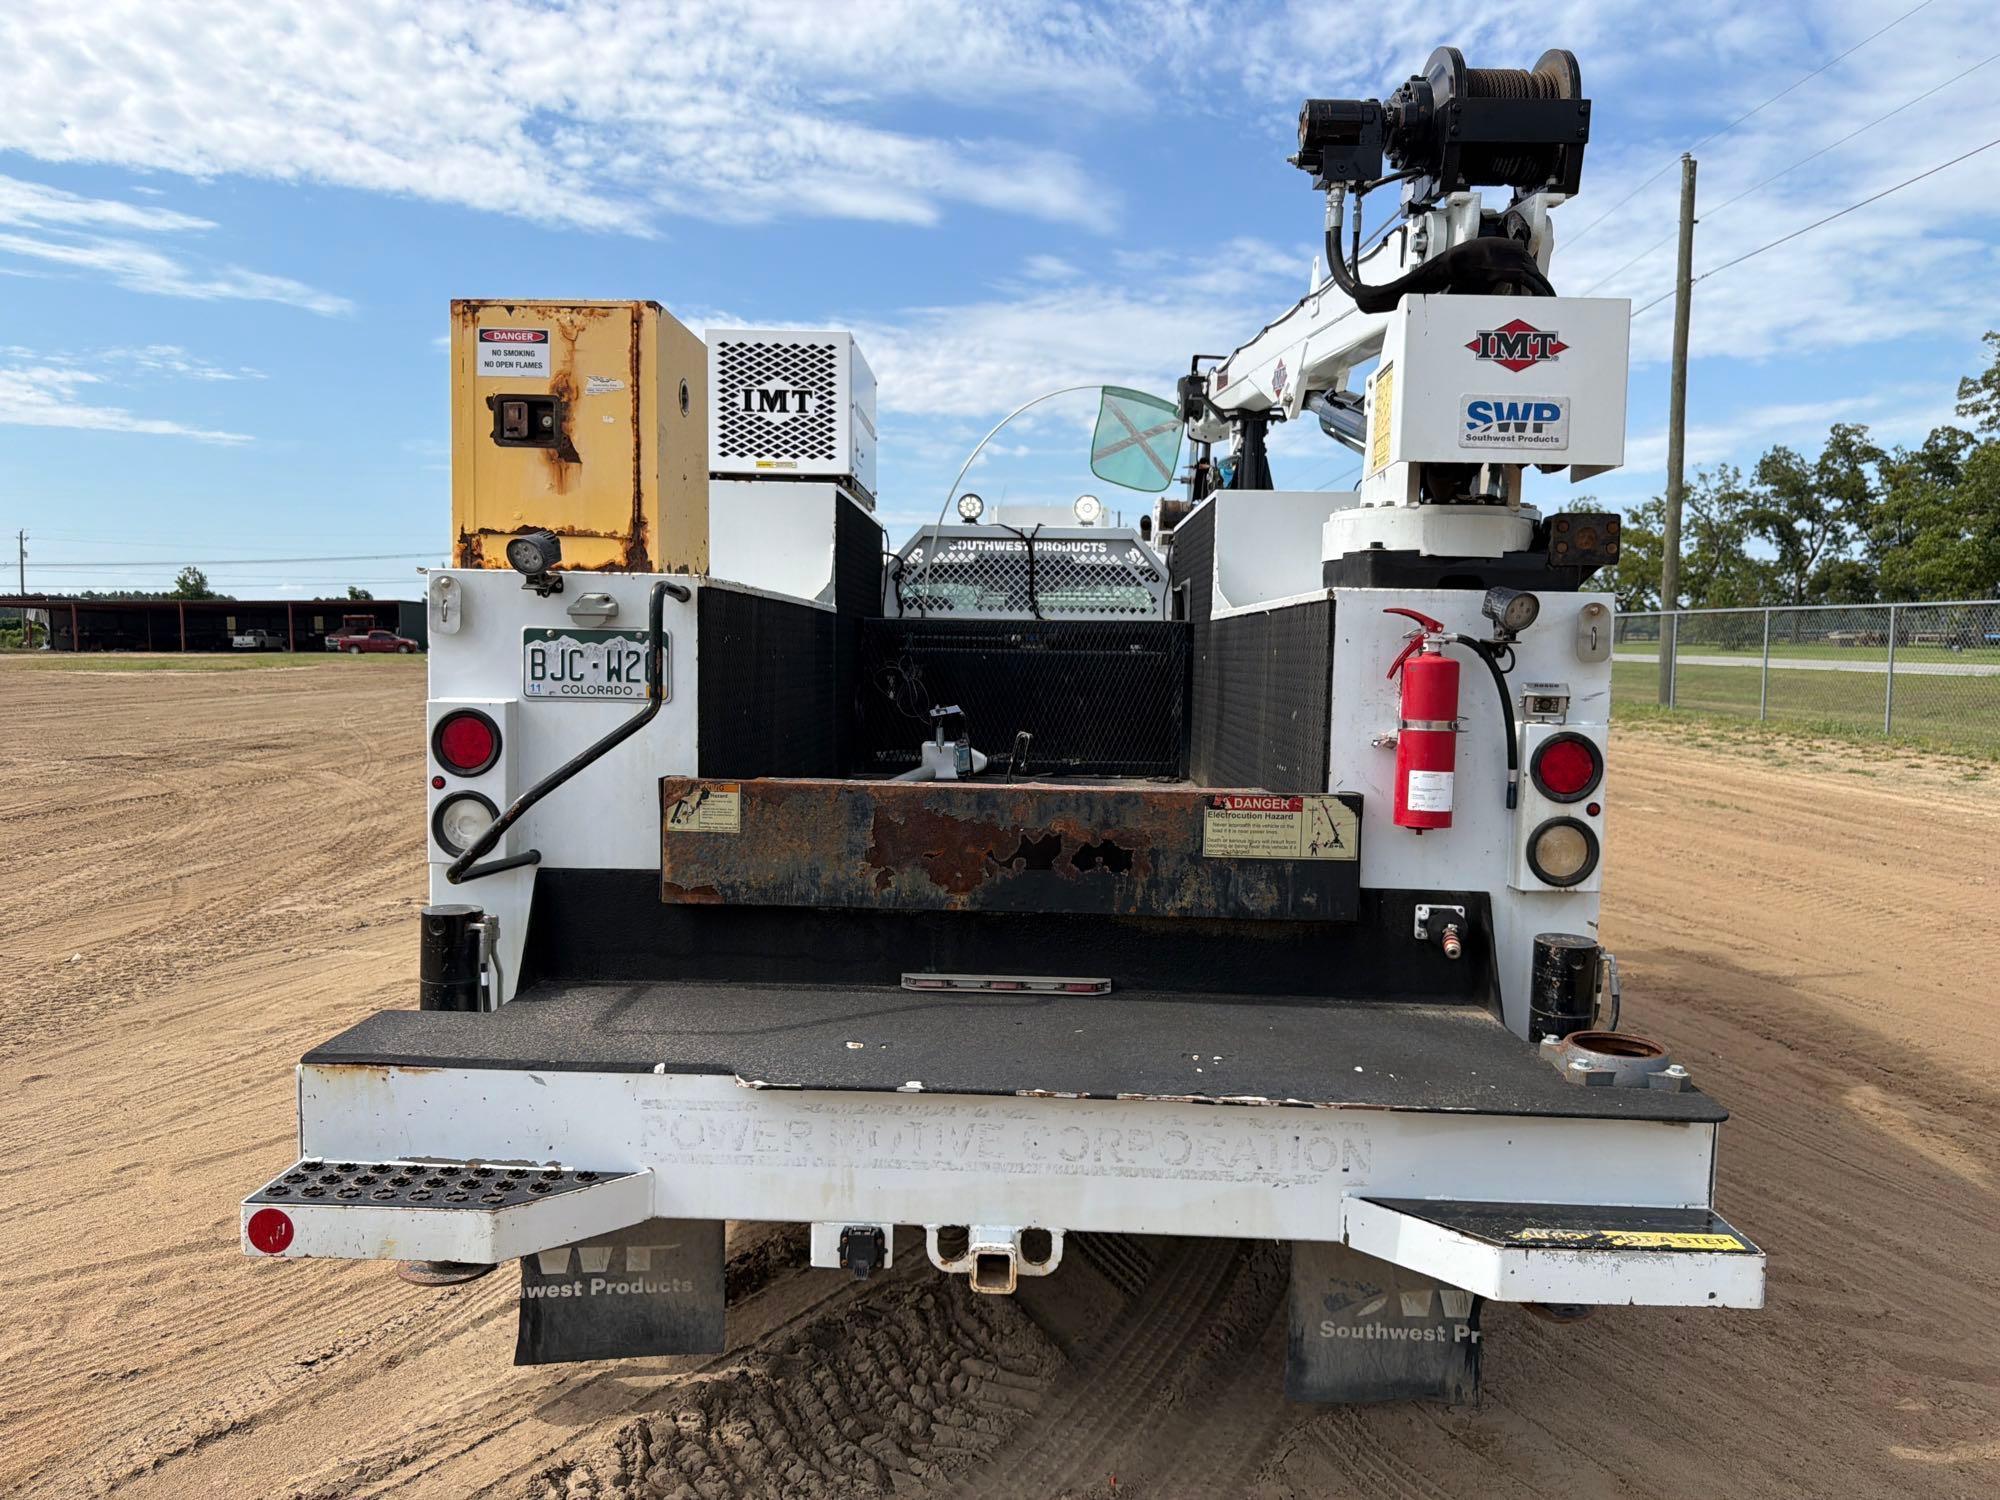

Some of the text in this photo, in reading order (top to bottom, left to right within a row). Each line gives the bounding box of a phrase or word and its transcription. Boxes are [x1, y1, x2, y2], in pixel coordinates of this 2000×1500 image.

[493, 331, 534, 341] DANGER
[1478, 332, 1556, 360] IMT
[492, 349, 536, 358] NO SMOKING
[484, 360, 543, 370] NO OPEN FLAMES
[741, 388, 813, 414] IMT
[1466, 400, 1561, 434] SWP
[1465, 433, 1560, 444] Southwest Products
[948, 540, 1108, 553] SOUTHWEST PRODUCTS
[560, 684, 634, 696] COLORADO
[1234, 798, 1290, 809] DANGER
[1207, 810, 1294, 821] Electrocution Hazard
[1659, 1236, 1675, 1244] A
[1675, 1236, 1739, 1247] STEP!
[590, 1275, 694, 1297] Products
[1319, 1319, 1446, 1343] Southwest
